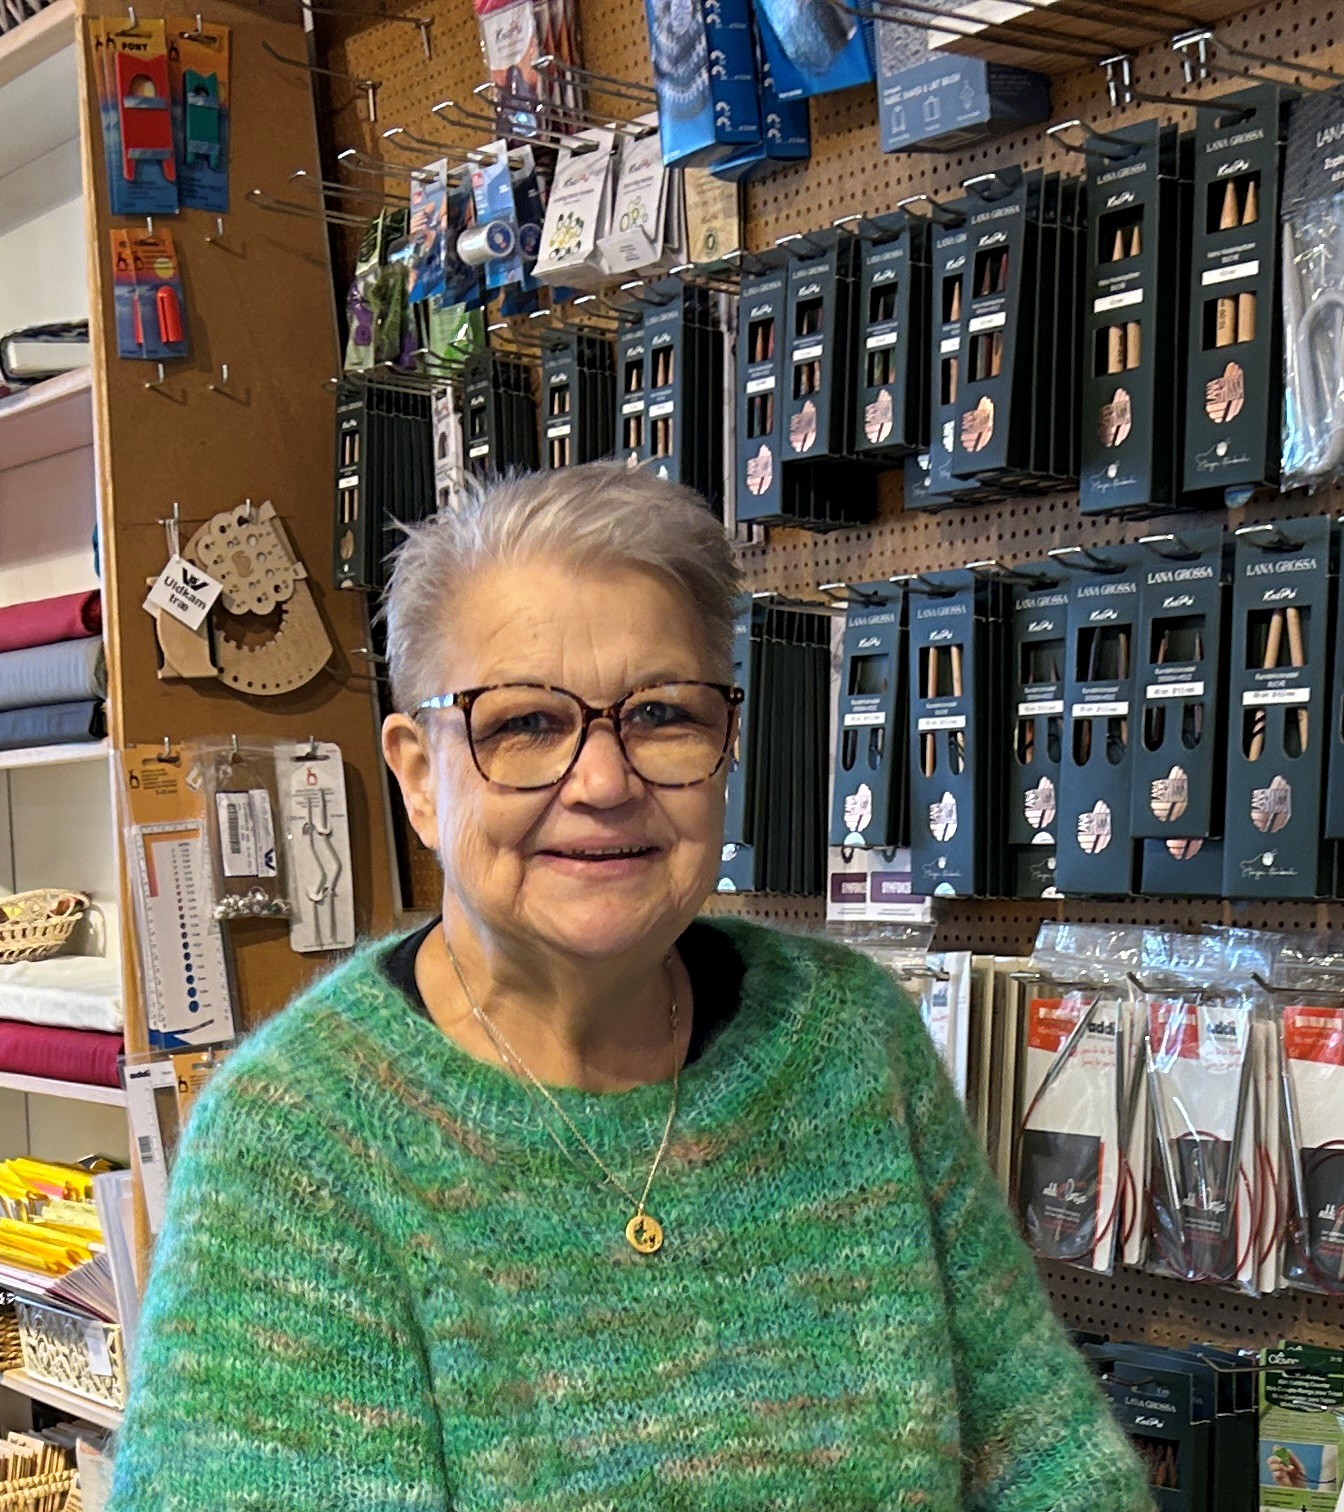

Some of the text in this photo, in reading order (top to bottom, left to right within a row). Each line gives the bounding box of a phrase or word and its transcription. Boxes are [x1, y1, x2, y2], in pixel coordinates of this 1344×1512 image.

[122, 42, 147, 51] PONY
[1147, 566, 1214, 585] LANA GROSSA
[1246, 557, 1317, 577] LANA GROSSA
[164, 576, 206, 610] Uldkam
[169, 593, 189, 612] træ
